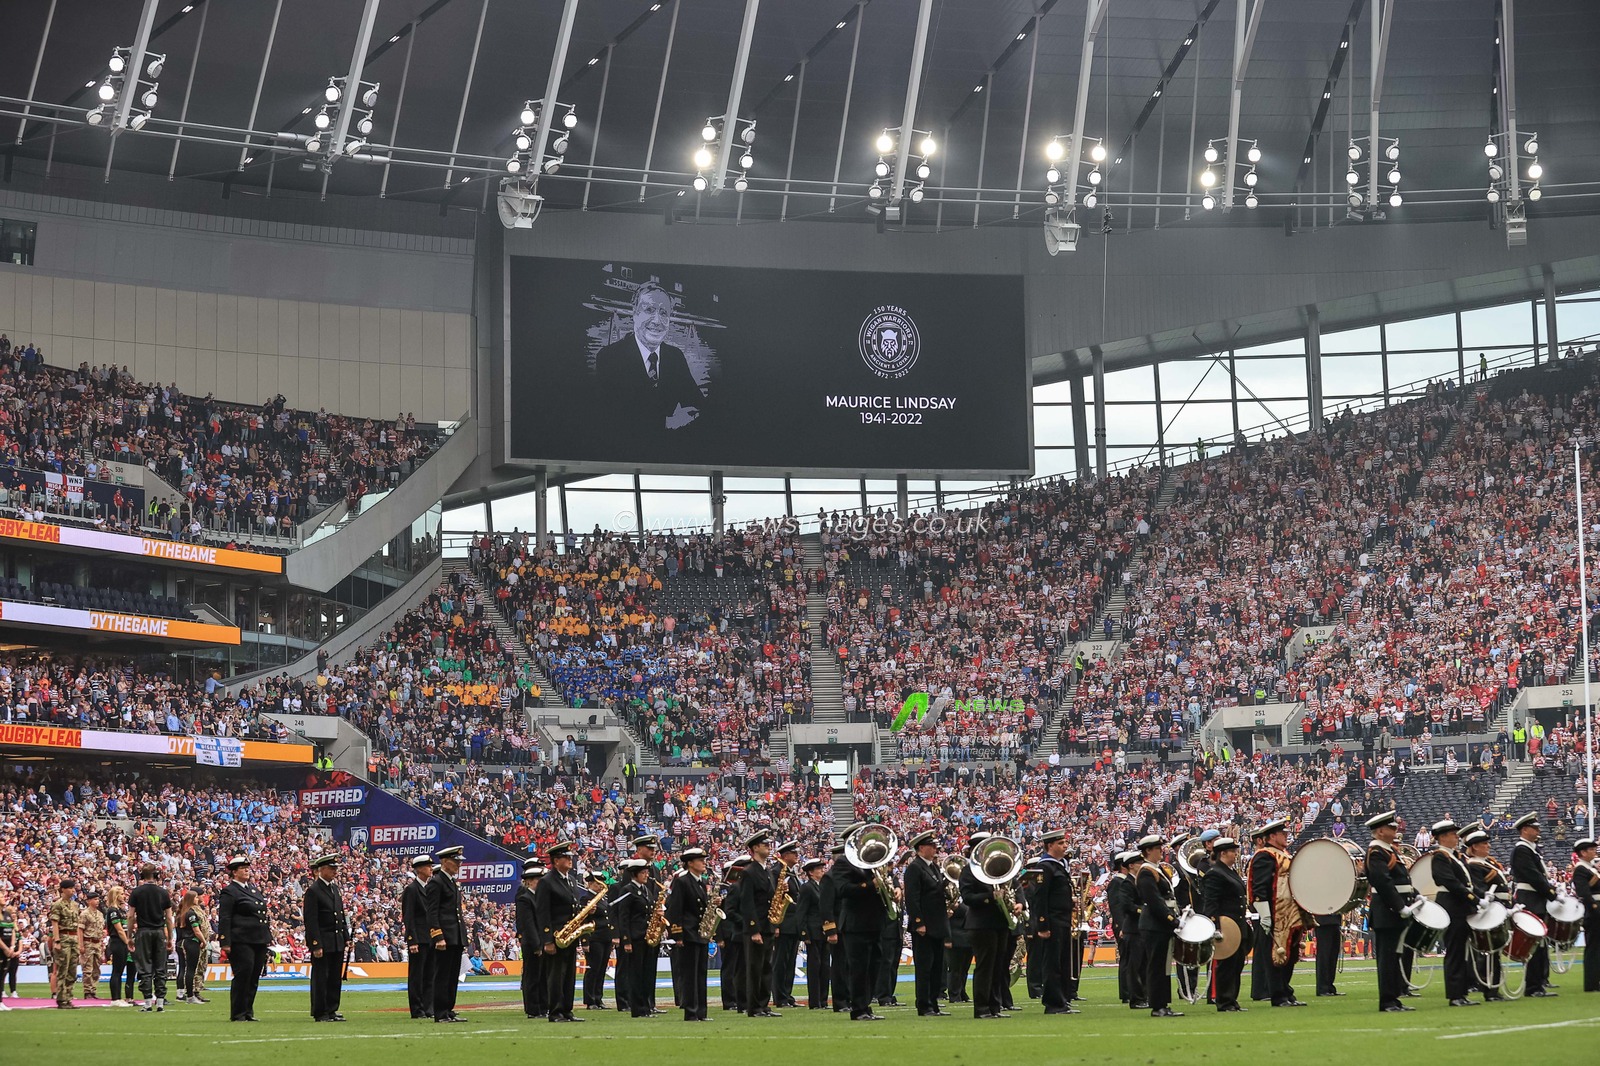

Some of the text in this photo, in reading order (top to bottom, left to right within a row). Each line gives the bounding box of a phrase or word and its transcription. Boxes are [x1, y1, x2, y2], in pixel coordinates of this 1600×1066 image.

[887, 305, 907, 316] YEARS
[866, 315, 913, 339] WIGAN WARRIORS
[826, 395, 956, 410] MAURICE LINDSAY
[860, 412, 923, 425] 1941-2022
[47, 482, 62, 490] WIGA
[302, 788, 363, 806] BETFRED
[346, 808, 361, 818] CUP
[373, 825, 437, 843] BETFRED
[419, 845, 435, 854] CUP
[458, 863, 515, 880] ETFRED
[496, 884, 512, 893] CUP
